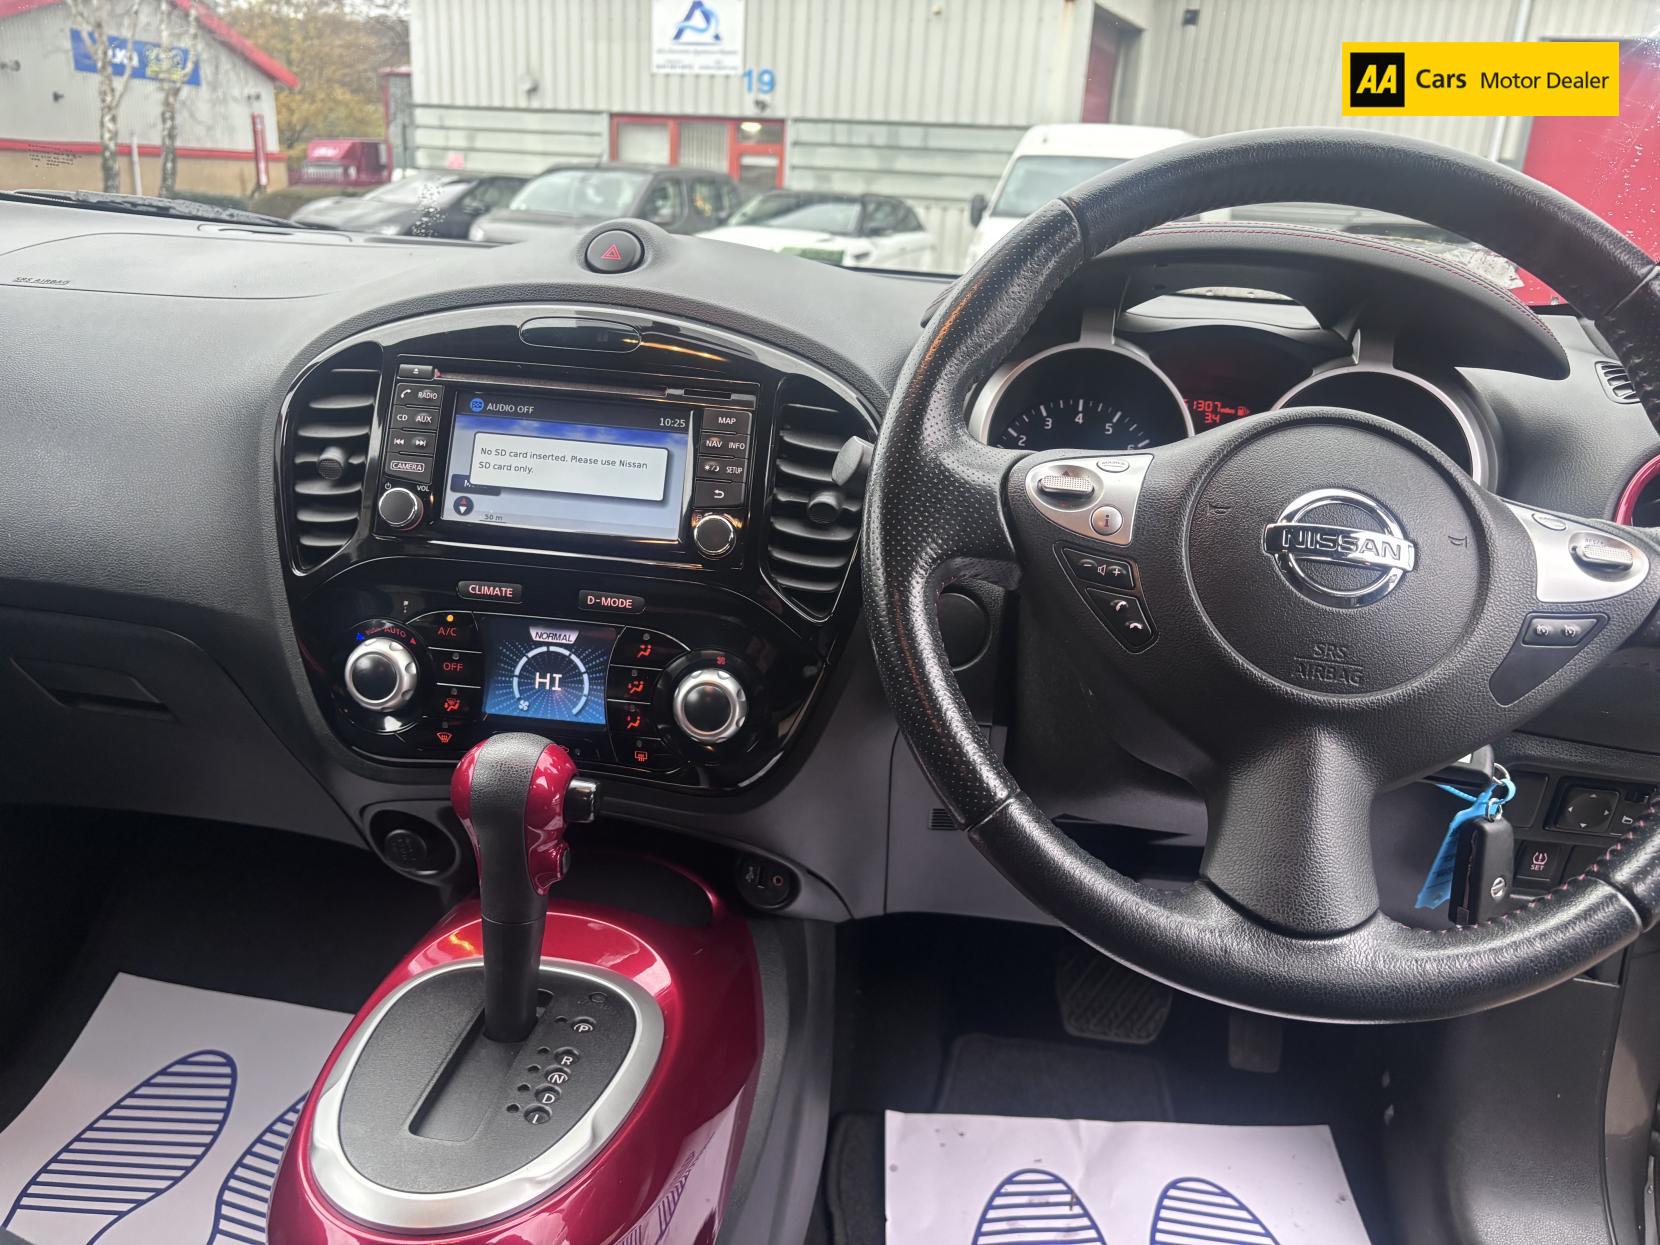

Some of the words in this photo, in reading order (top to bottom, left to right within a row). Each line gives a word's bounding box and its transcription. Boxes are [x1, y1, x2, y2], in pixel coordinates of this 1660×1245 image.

[744, 68, 776, 94] 19
[418, 391, 438, 400] RADIO
[486, 402, 515, 413] AUDIO
[517, 406, 535, 414] OFF
[397, 414, 408, 422] CD
[416, 415, 432, 423] AUX
[659, 417, 686, 428] 10:25
[718, 416, 737, 425] MAP
[1044, 418, 1053, 429] 3
[1075, 413, 1084, 424] 4
[1104, 423, 1113, 434] 5
[706, 440, 723, 448] NAV
[728, 441, 745, 450] INFO
[1018, 435, 1027, 446] 2
[480, 447, 493, 456] No
[494, 448, 507, 457] SD
[508, 449, 528, 459] card
[529, 451, 568, 463] inserted.
[570, 455, 599, 465] Please
[601, 458, 616, 467] use
[619, 460, 648, 470] Nissan
[391, 462, 425, 471] CAMERA
[478, 462, 491, 470] SD
[492, 462, 512, 472] card
[514, 464, 534, 475] only.
[726, 465, 743, 474] SETUP
[1282, 528, 1401, 561] NISSAN
[468, 584, 513, 597] CLIMATE
[587, 595, 633, 609] D-MODE
[384, 626, 407, 638] AUTO
[437, 626, 457, 637] A/C
[535, 631, 573, 643] NORMAL
[1313, 643, 1347, 661] SRS
[443, 662, 464, 671] OFF
[1295, 661, 1364, 687] AIRBAG
[535, 672, 563, 691] HI
[578, 1023, 589, 1032] P
[561, 1056, 573, 1066] R
[552, 1074, 565, 1084] N
[542, 1093, 555, 1104] D
